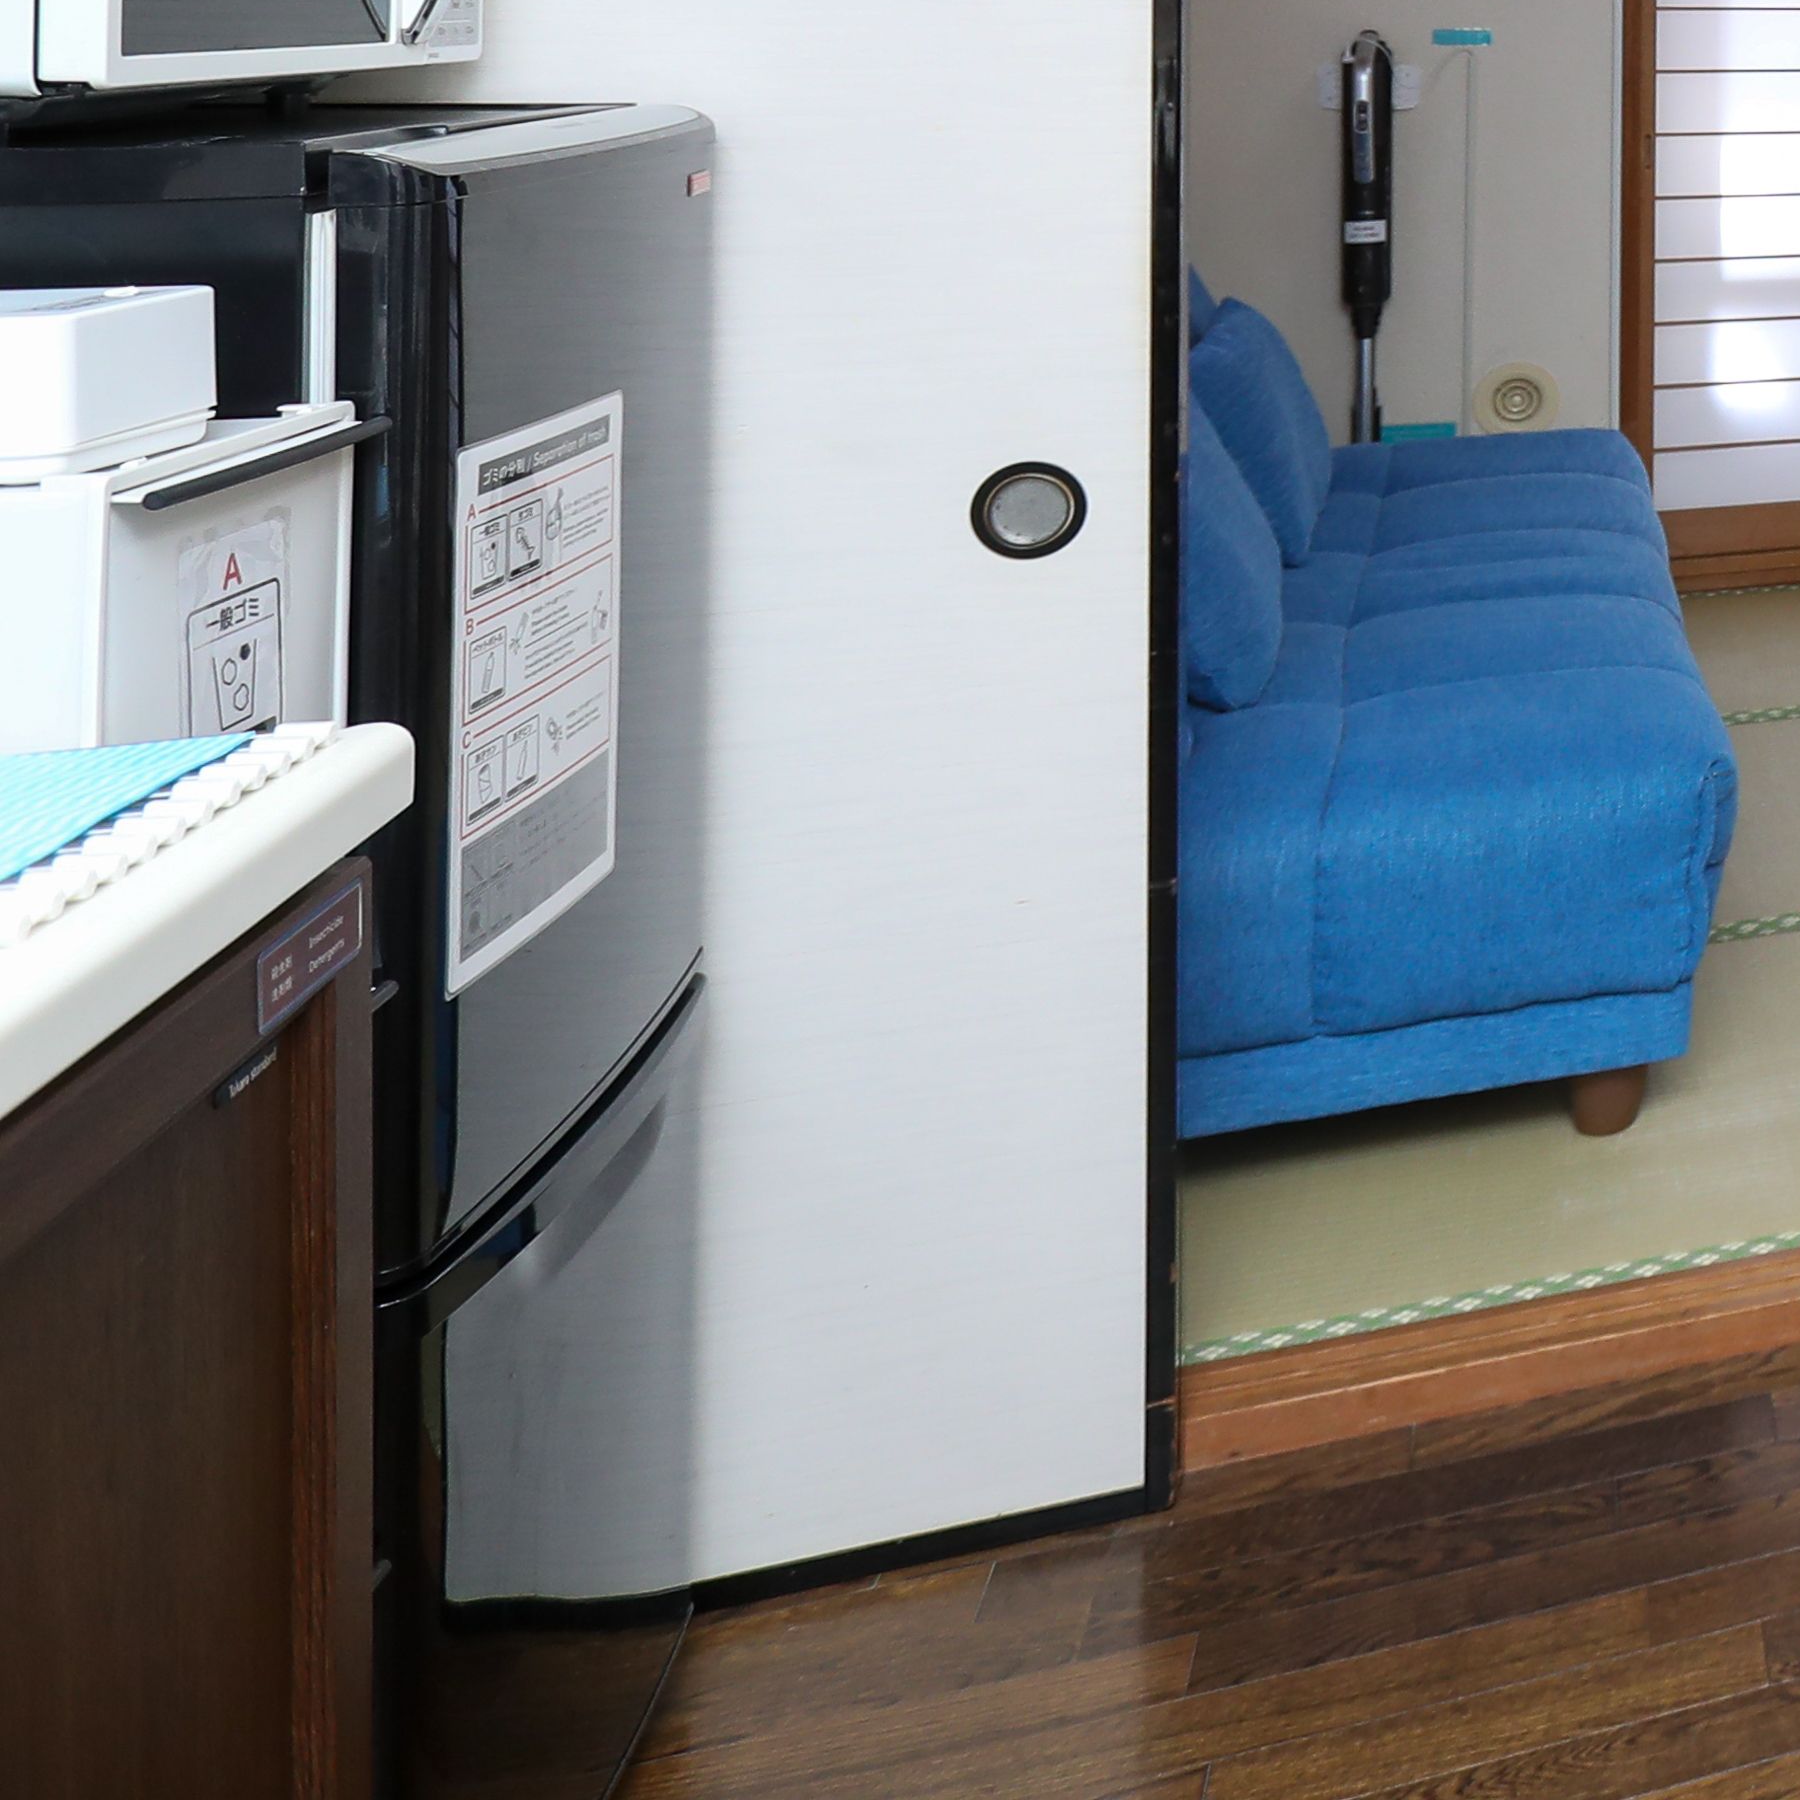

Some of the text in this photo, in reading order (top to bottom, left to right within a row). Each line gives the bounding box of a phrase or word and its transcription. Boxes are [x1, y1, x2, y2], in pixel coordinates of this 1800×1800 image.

[483, 458, 525, 486] ゴミの分別
[533, 438, 578, 467] Separation
[578, 433, 587, 447] of
[588, 425, 606, 444] trash
[467, 503, 477, 521] A
[223, 553, 243, 591] A
[206, 597, 260, 631] 一般ゴミ
[466, 618, 474, 636] B
[462, 731, 471, 749] C
[308, 915, 344, 949] Insecticide
